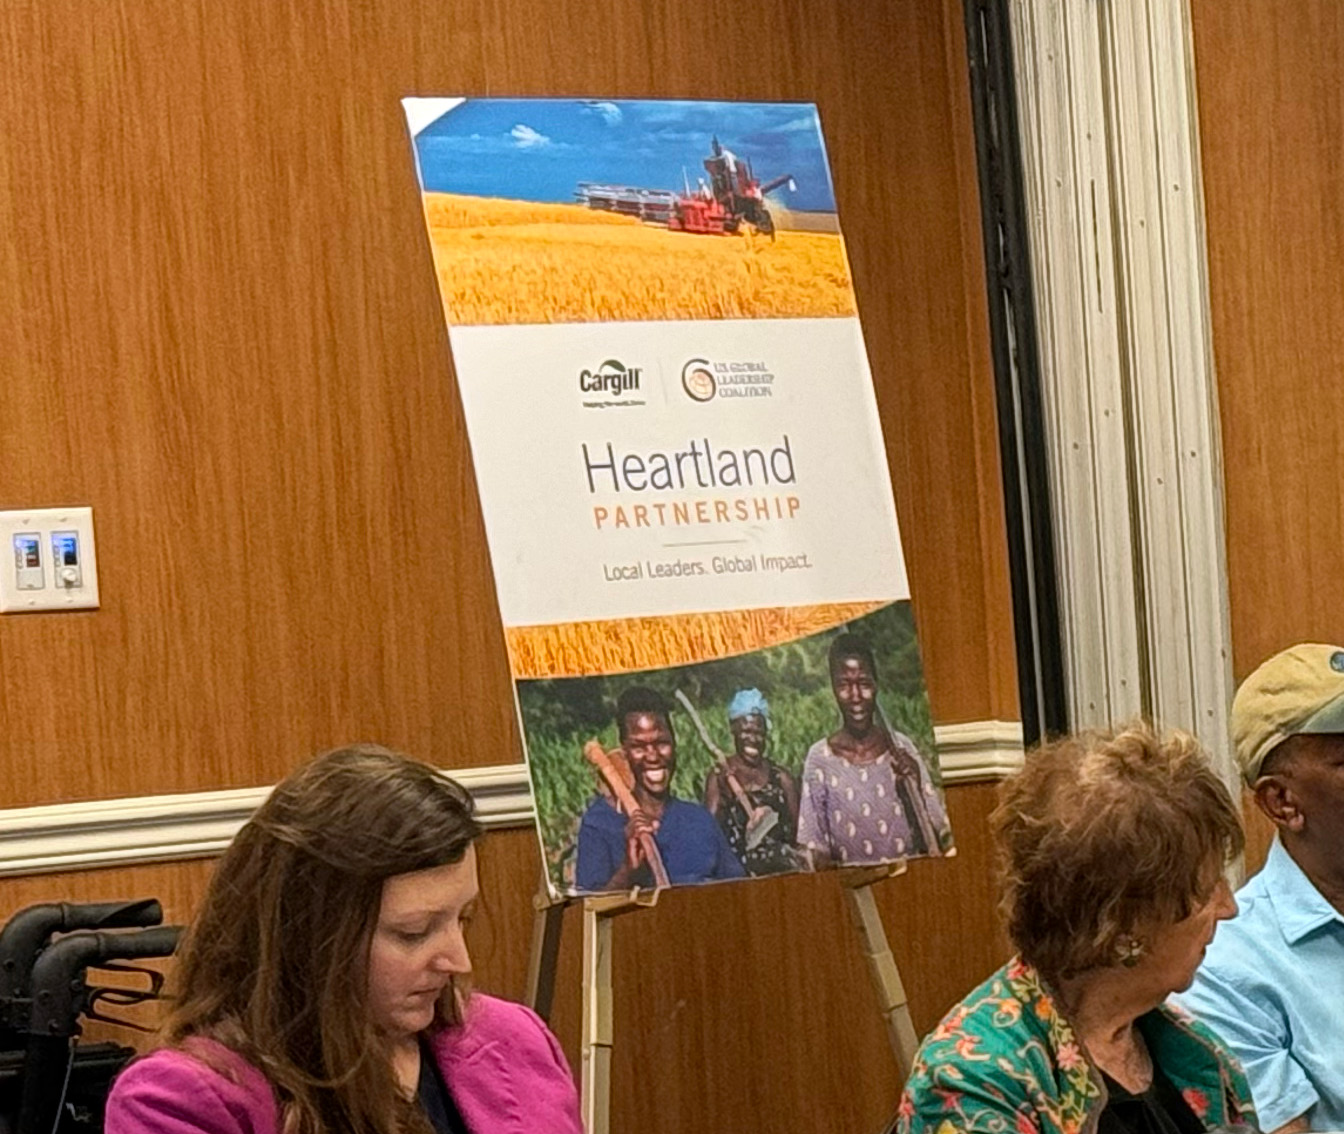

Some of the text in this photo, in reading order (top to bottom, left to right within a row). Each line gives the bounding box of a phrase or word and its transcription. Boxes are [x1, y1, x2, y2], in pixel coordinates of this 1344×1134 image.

[580, 366, 640, 396] Cargill
[582, 434, 796, 493] Heartland
[594, 496, 800, 529] PARTNERSHIP
[603, 553, 812, 582] Local Leaders. Global Impact.
